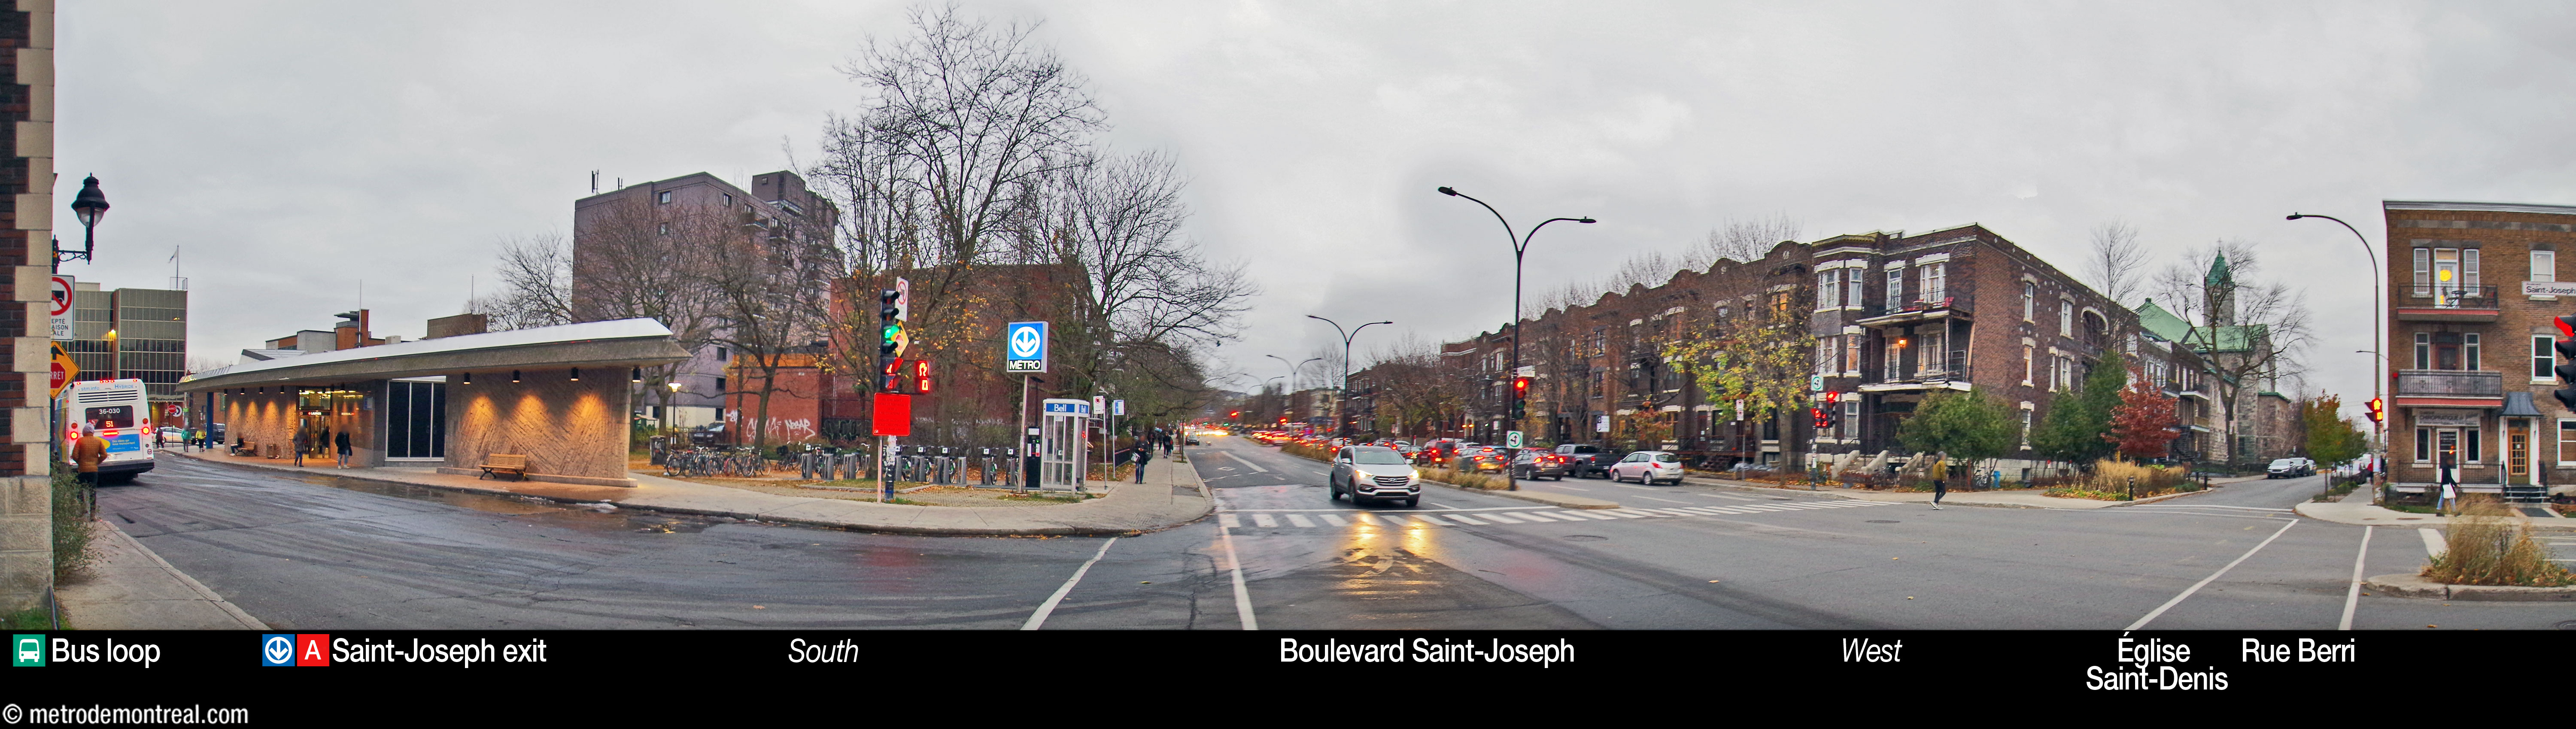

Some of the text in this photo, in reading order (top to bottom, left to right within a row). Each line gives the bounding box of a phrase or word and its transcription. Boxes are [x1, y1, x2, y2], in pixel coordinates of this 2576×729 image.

[2526, 286, 2576, 295] Saint-Joseph
[1009, 360, 1041, 370] MÉTRO
[50, 370, 64, 380] RRÊT
